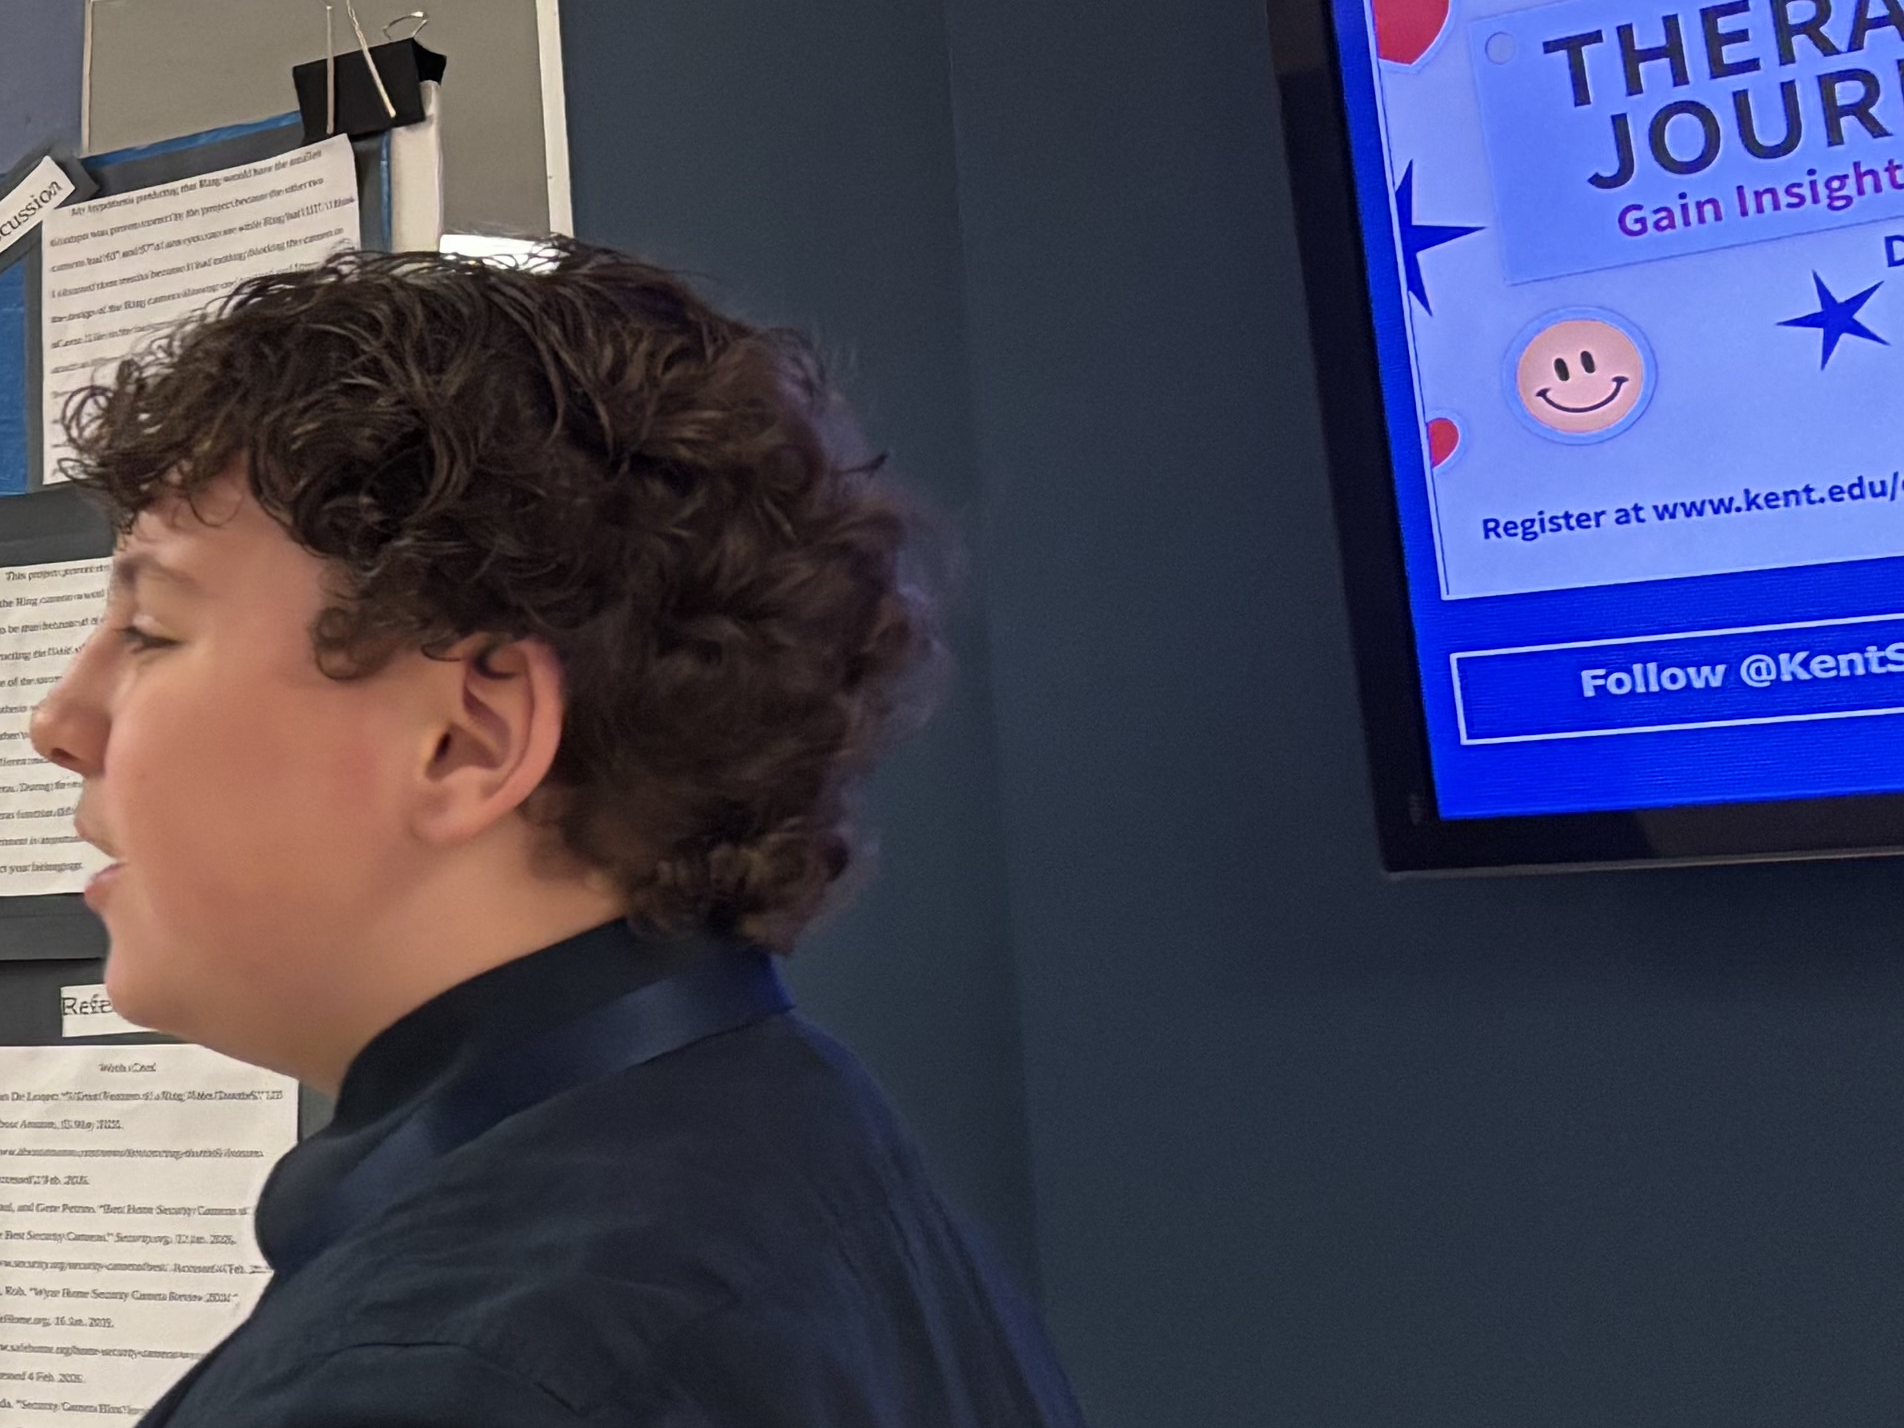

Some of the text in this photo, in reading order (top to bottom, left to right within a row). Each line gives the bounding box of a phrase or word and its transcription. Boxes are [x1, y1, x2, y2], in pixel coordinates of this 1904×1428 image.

[1588, 58, 1904, 190] JOUR
[1616, 193, 1724, 238] Gain
[1482, 470, 1904, 541] Register at www.kent.edu/
[1581, 658, 1725, 698] Follow
